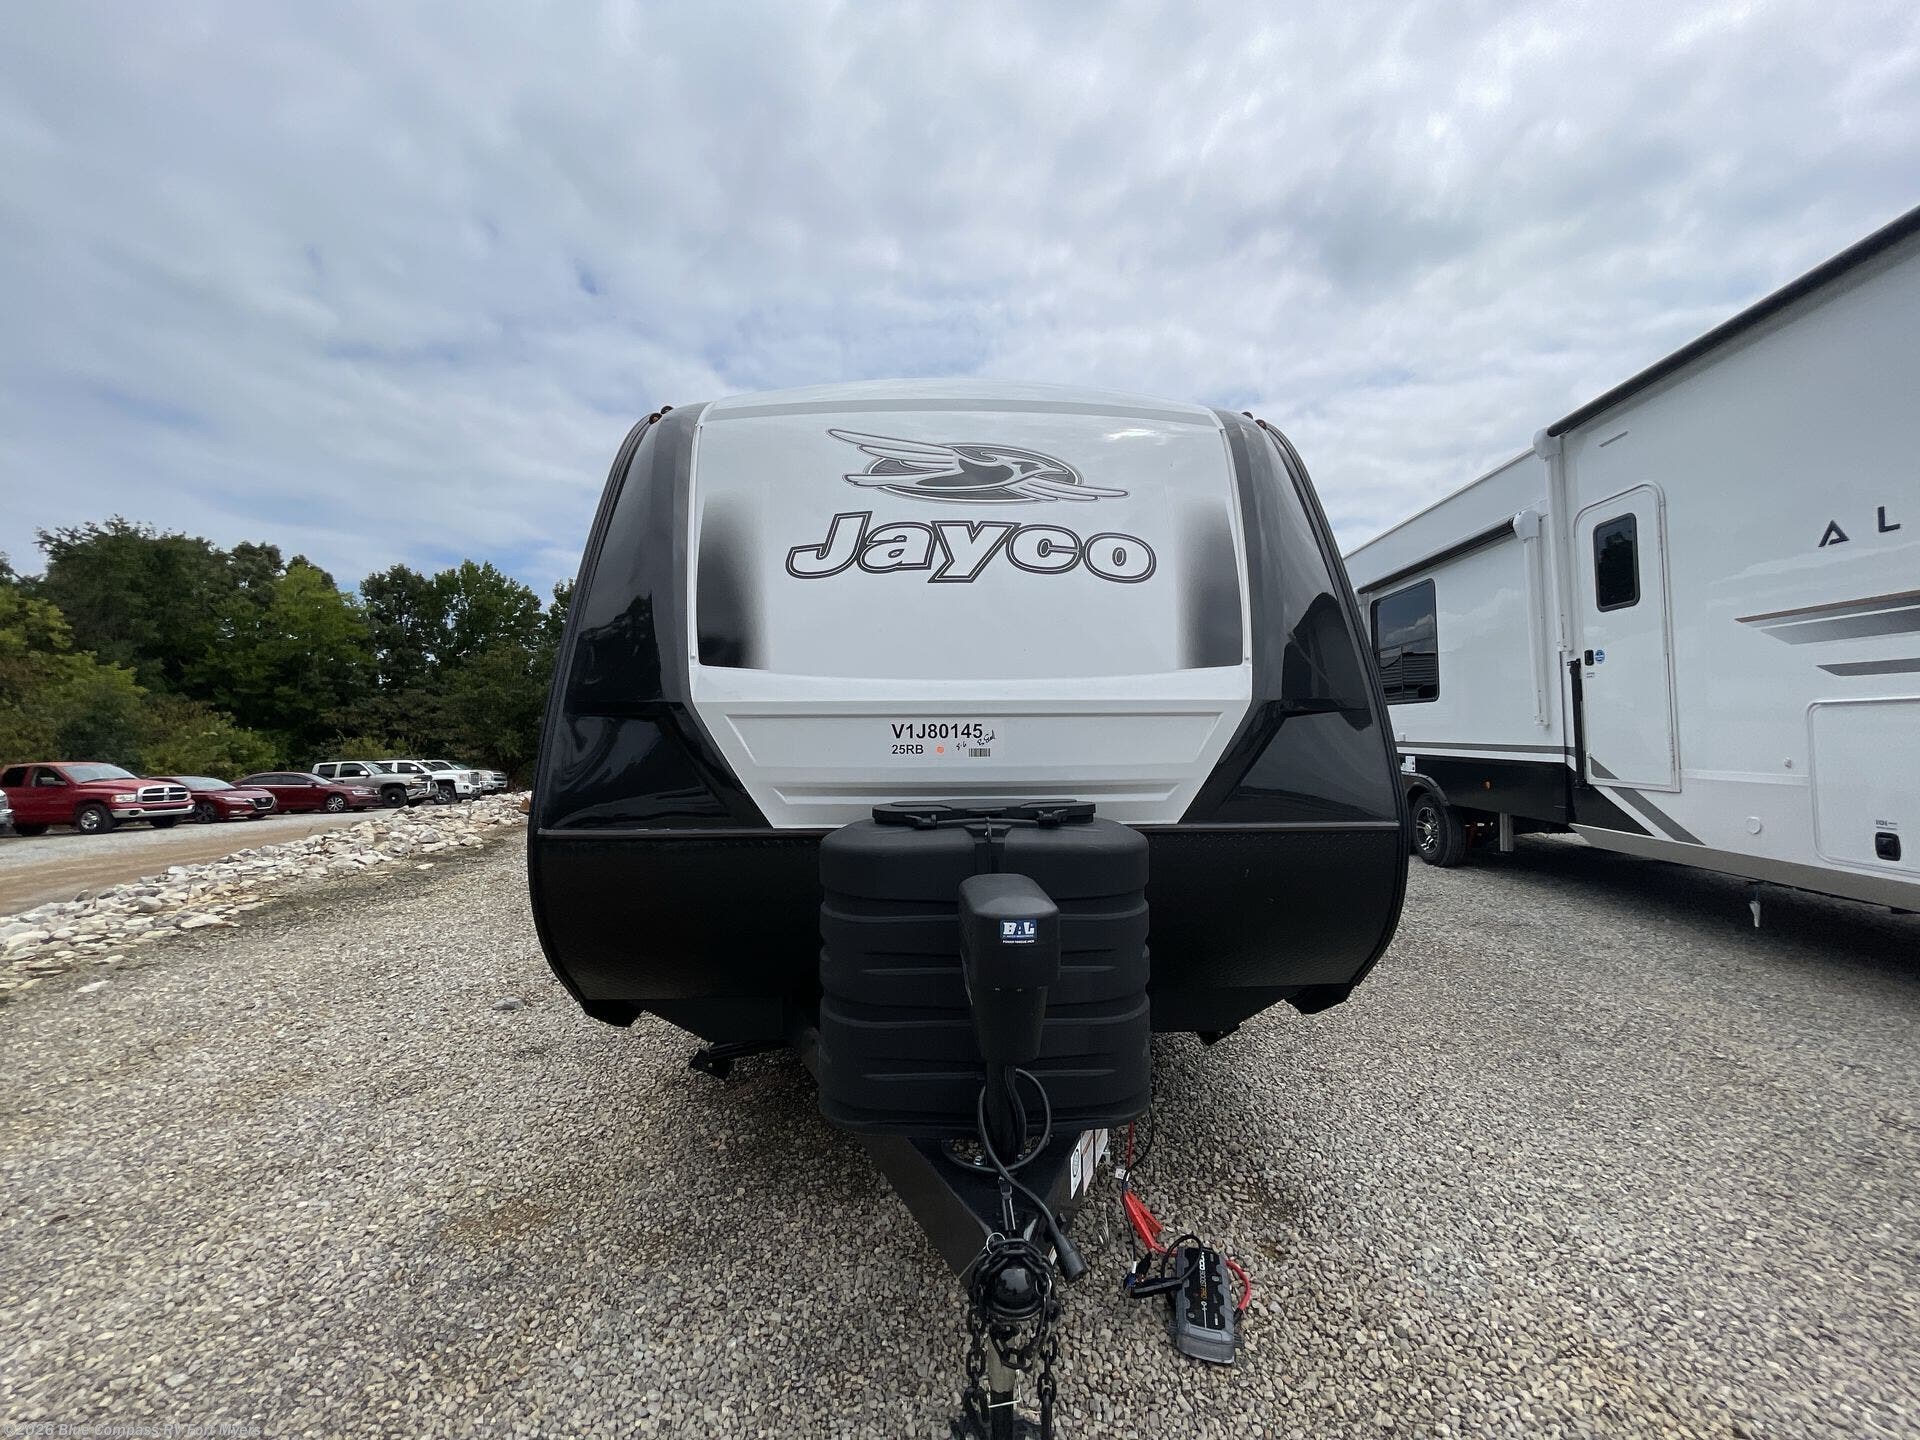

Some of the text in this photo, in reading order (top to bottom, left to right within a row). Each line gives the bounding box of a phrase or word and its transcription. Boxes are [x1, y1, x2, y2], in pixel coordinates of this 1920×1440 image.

[785, 511, 1156, 583] Jayco
[891, 724, 983, 739] V1J80145
[891, 744, 924, 755] 25RB
